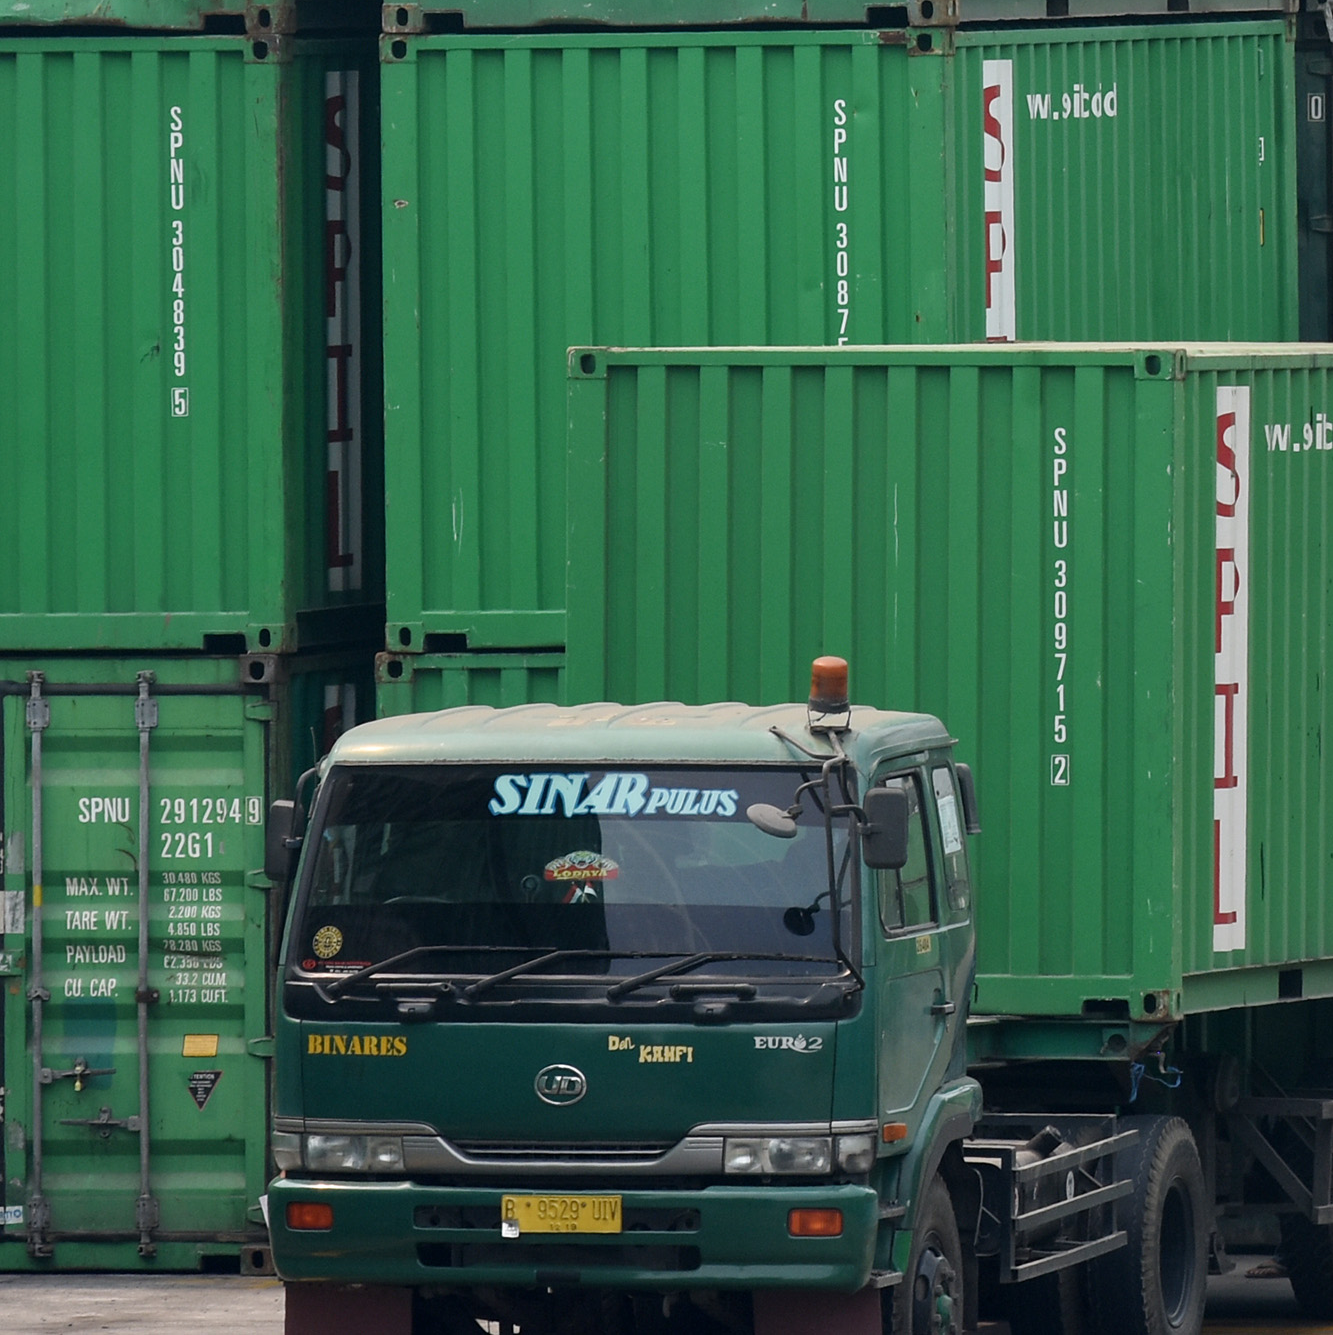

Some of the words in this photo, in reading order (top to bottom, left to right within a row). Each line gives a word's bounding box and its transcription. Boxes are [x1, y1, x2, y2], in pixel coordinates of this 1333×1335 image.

[171, 107, 183, 210] SPNU
[834, 99, 848, 211] SPNU
[836, 223, 849, 346] 3087
[172, 221, 185, 377] 304839
[172, 388, 188, 416] 5
[1053, 427, 1067, 548] SPNU
[1055, 560, 1067, 743] 309715
[1052, 757, 1068, 784] 2
[488, 772, 649, 817] SINAR
[646, 788, 740, 817] PULUS
[78, 797, 130, 823] SPNU
[160, 798, 242, 823] 291294
[161, 832, 213, 858] 22G1
[65, 877, 103, 896] MAX.
[106, 877, 134, 896] WT.
[163, 872, 198, 884] 30.480
[201, 872, 221, 884] KGS
[163, 888, 198, 902] 67.200
[202, 888, 222, 902] LBS
[65, 911, 98, 930] TARE
[105, 911, 132, 930] WT.
[169, 905, 198, 918] 2.200
[201, 905, 222, 918] KGS
[168, 922, 196, 936] 4.850
[201, 922, 221, 936] LBS
[66, 945, 126, 964] PAYLOAD
[201, 939, 222, 952] KGS
[64, 978, 84, 997] CU.
[90, 978, 118, 997] CAP.
[175, 973, 197, 986] 33.2
[170, 989, 197, 1003] 1.173
[307, 1034, 408, 1058] BINARES
[505, 1199, 515, 1220] B
[538, 1199, 579, 1220] 9529
[592, 1199, 618, 1221] UIV
